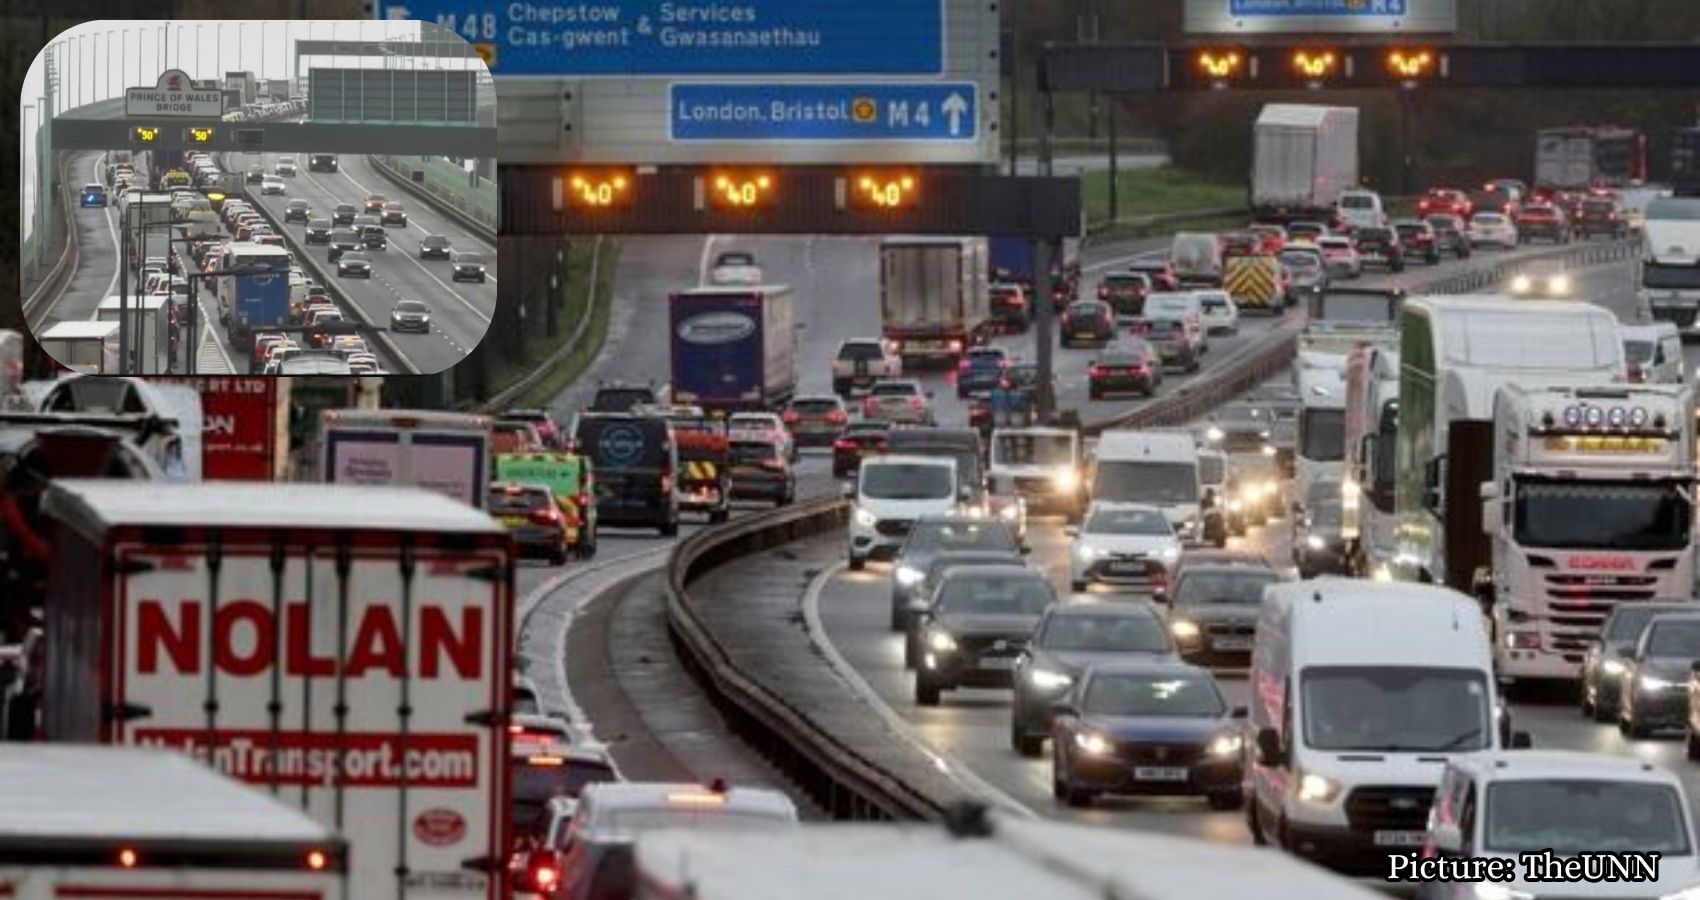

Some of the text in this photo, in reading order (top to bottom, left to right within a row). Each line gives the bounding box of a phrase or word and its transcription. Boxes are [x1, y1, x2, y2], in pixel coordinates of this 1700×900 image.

[507, 2, 621, 23] Chepstow
[659, 2, 756, 22] Services
[636, 16, 652, 35] &
[507, 26, 629, 48] Cas-gwent
[659, 27, 820, 47] Gwasanaethau
[130, 92, 219, 103] PRINCE OF WALES
[156, 103, 193, 112] BRIDGE
[771, 100, 848, 121] Bristol
[888, 100, 930, 127] M4
[141, 130, 153, 141] 50
[195, 130, 207, 141] 50
[583, 183, 612, 205] 40
[726, 183, 756, 205] 40
[871, 183, 900, 206] 40
[136, 599, 483, 680] NOLAN
[140, 737, 474, 787] nTransport.com
